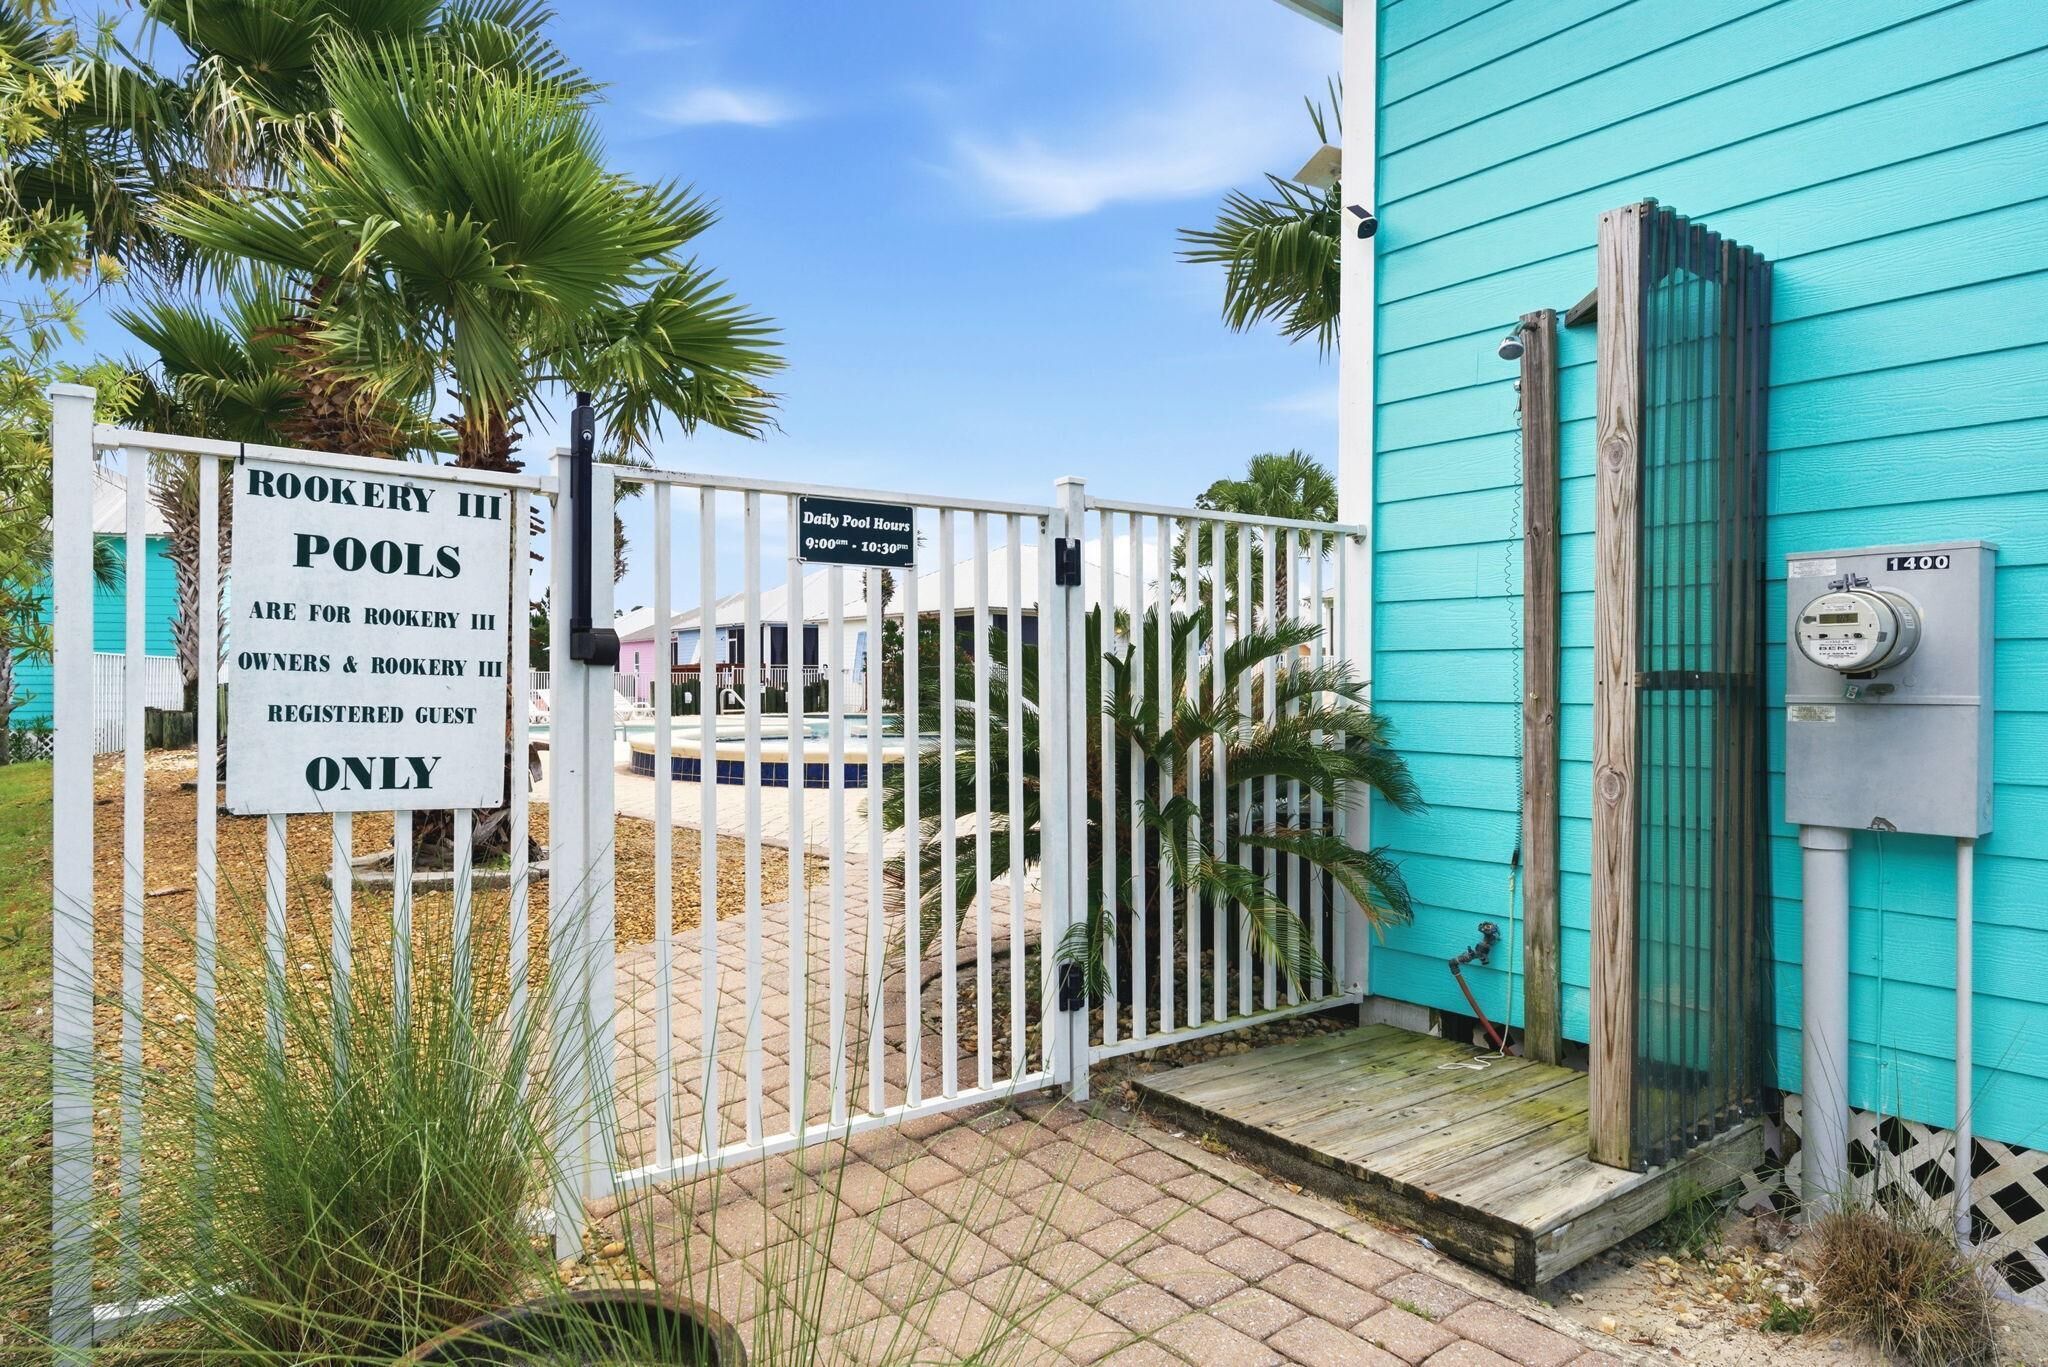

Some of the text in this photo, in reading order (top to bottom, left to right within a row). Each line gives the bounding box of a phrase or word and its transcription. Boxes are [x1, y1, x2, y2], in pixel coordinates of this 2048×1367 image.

[247, 468, 502, 520] ROOKERY III
[803, 511, 910, 532] Daily Pool Hours
[292, 532, 462, 579] POOLS
[805, 537, 848, 550] 9:00am
[861, 541, 909, 555] 10:30pm
[1890, 556, 1949, 570] 1400
[249, 601, 496, 631] ARE FOR ROOKERY III
[238, 651, 503, 678] OWNERS & ROOKERY III
[267, 704, 477, 725] REGISTERED GUEST
[305, 756, 442, 792] ONLY
